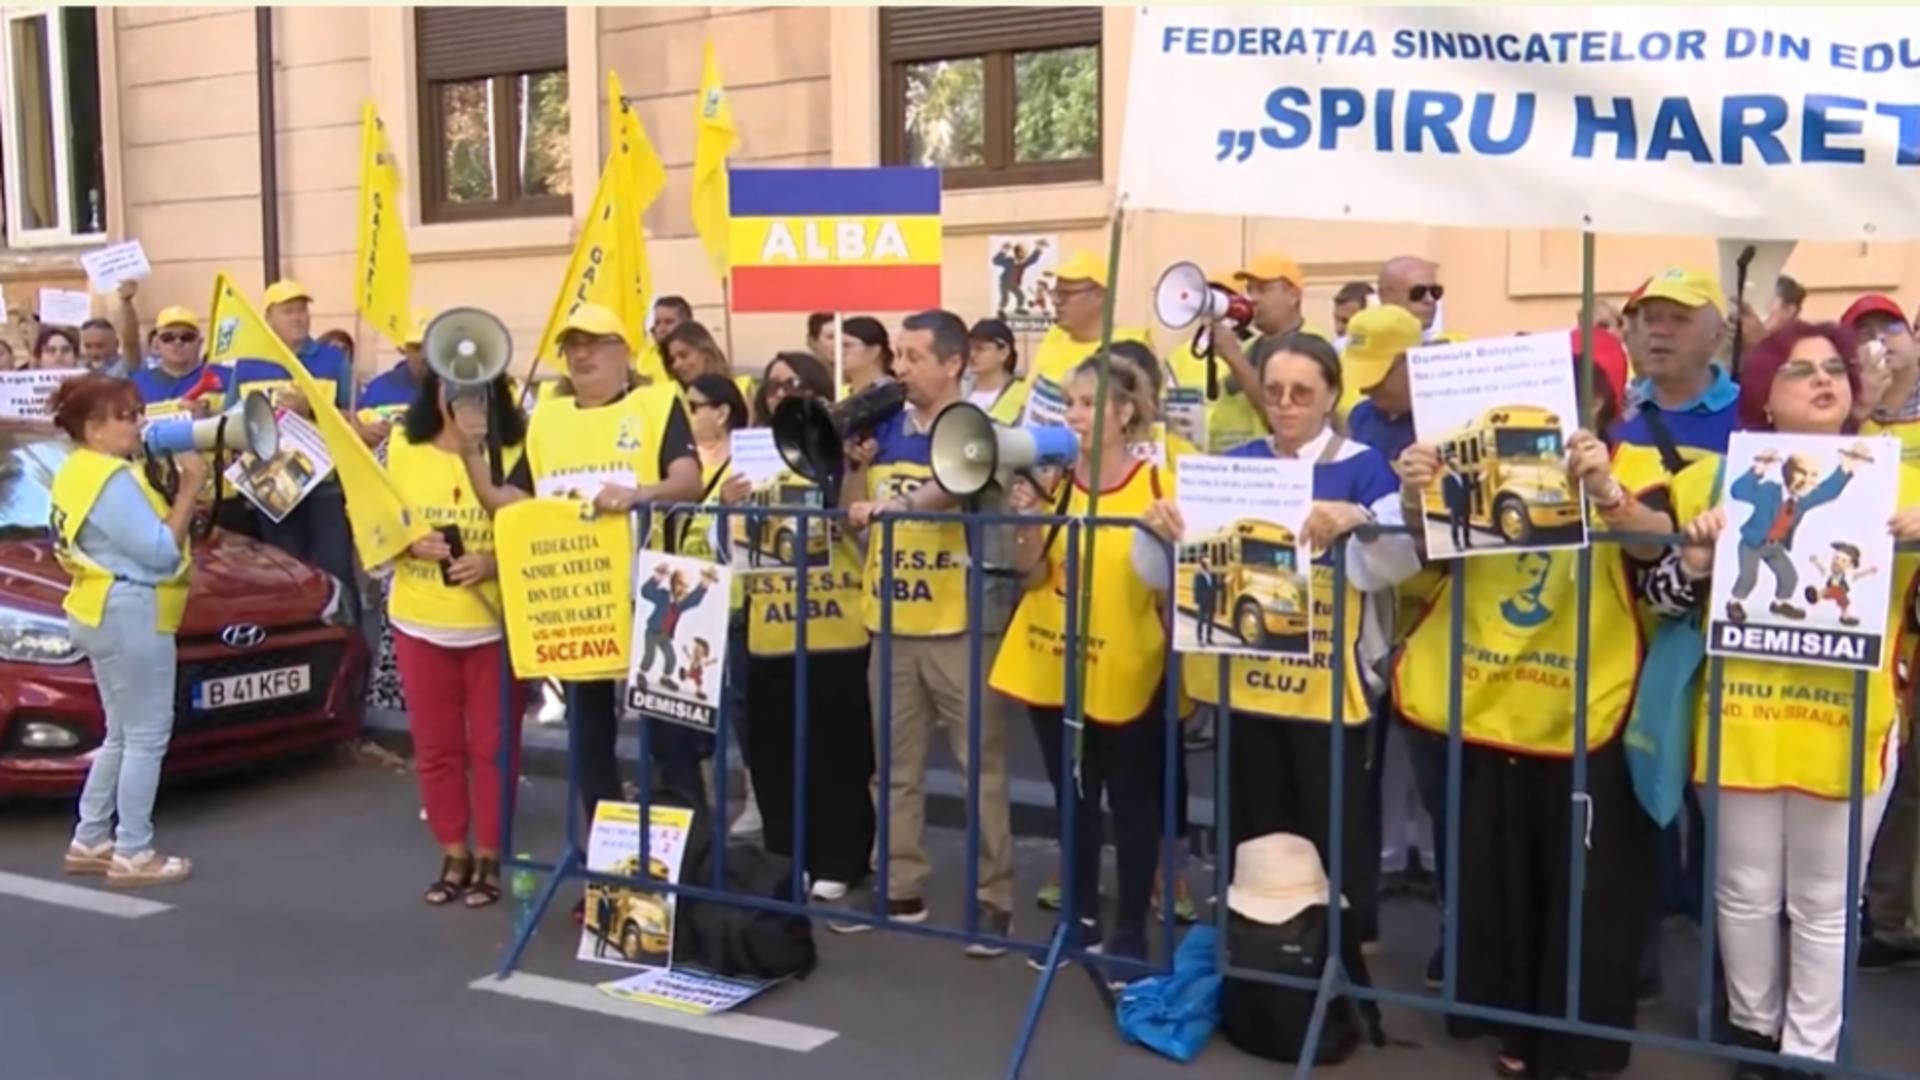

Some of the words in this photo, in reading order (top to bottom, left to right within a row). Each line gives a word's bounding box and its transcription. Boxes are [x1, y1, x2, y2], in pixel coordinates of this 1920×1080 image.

[1162, 26, 1376, 64] FEDERAȚIA
[1392, 29, 1707, 64] SINDICATELOR
[1725, 27, 1810, 61] DIN
[1572, 94, 1920, 166] HARET
[762, 221, 909, 260] ALBA
[1721, 625, 1867, 659] DEMISIA!
[209, 682, 225, 706] B
[233, 677, 254, 700] 41
[260, 669, 300, 698] KFG
[1246, 670, 1307, 695] CLUJ
[632, 689, 711, 725] DEMISIA!
